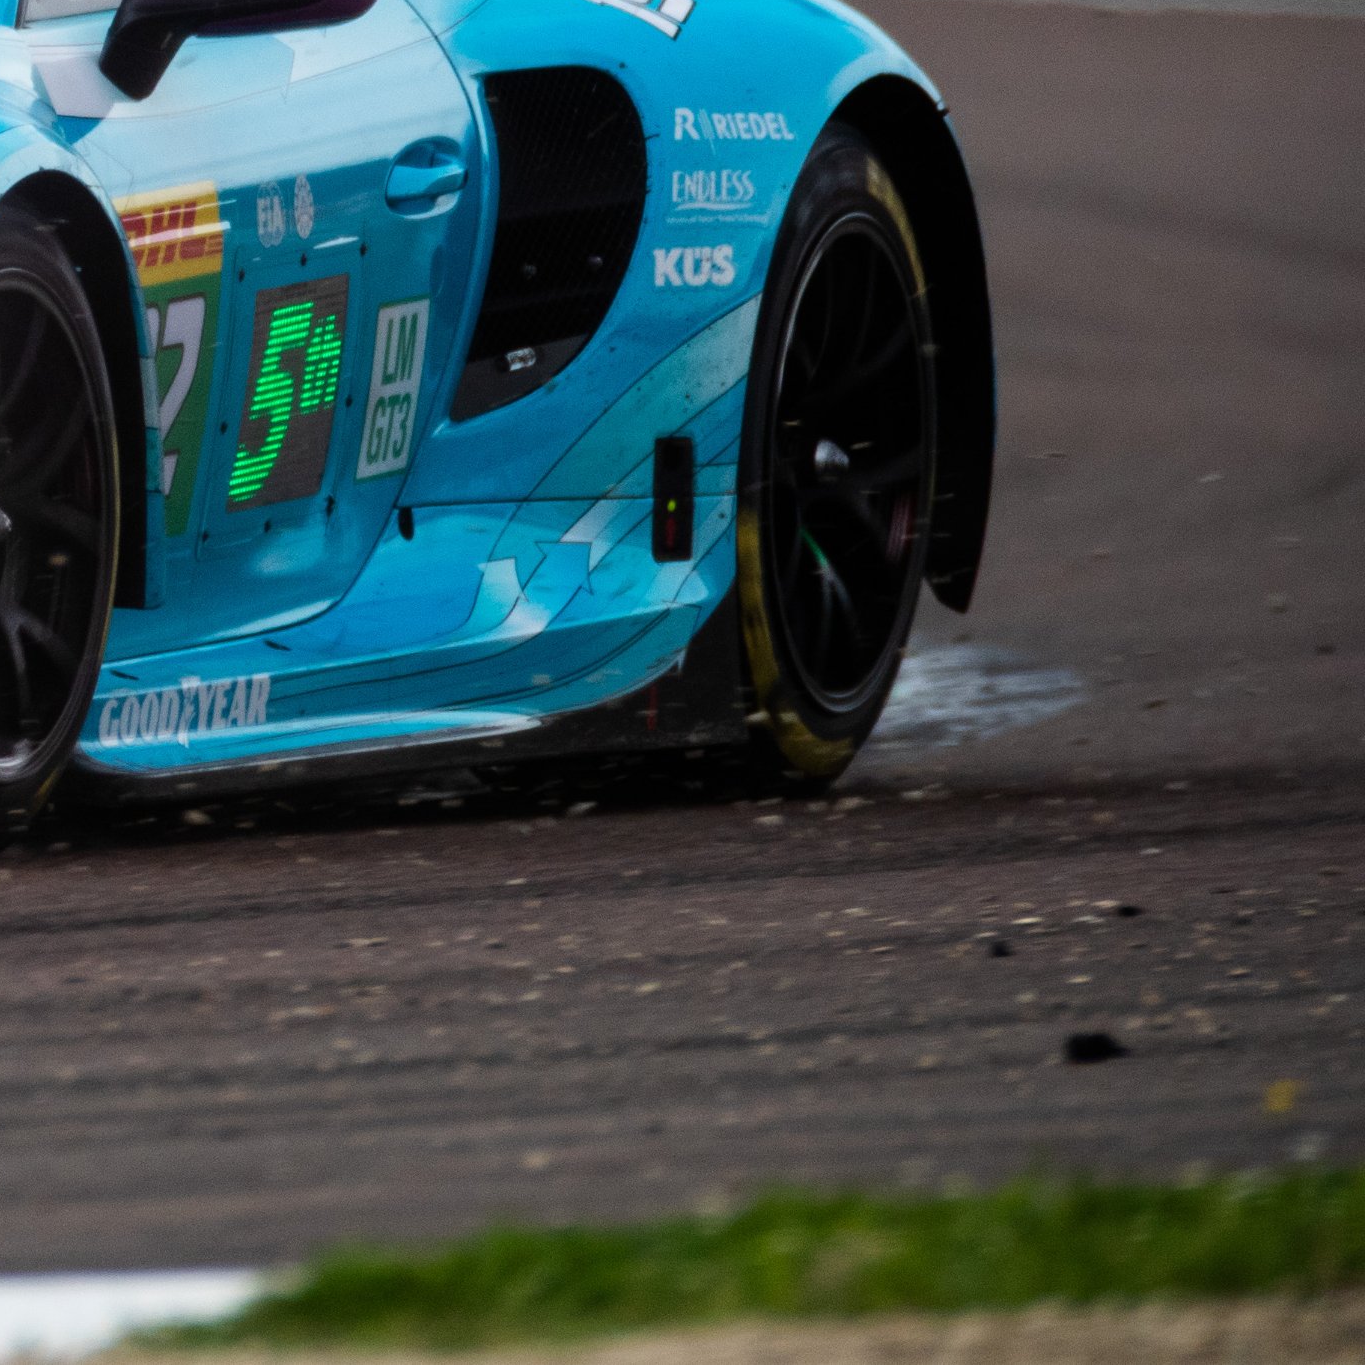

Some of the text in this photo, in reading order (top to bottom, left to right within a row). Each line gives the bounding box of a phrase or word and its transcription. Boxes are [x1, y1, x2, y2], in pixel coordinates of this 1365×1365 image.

[711, 112, 795, 141] RIEDEL
[671, 169, 755, 204] ENDLESS
[381, 311, 420, 387] LM
[364, 392, 412, 467] GT3
[98, 674, 271, 748] GOODYEAR
